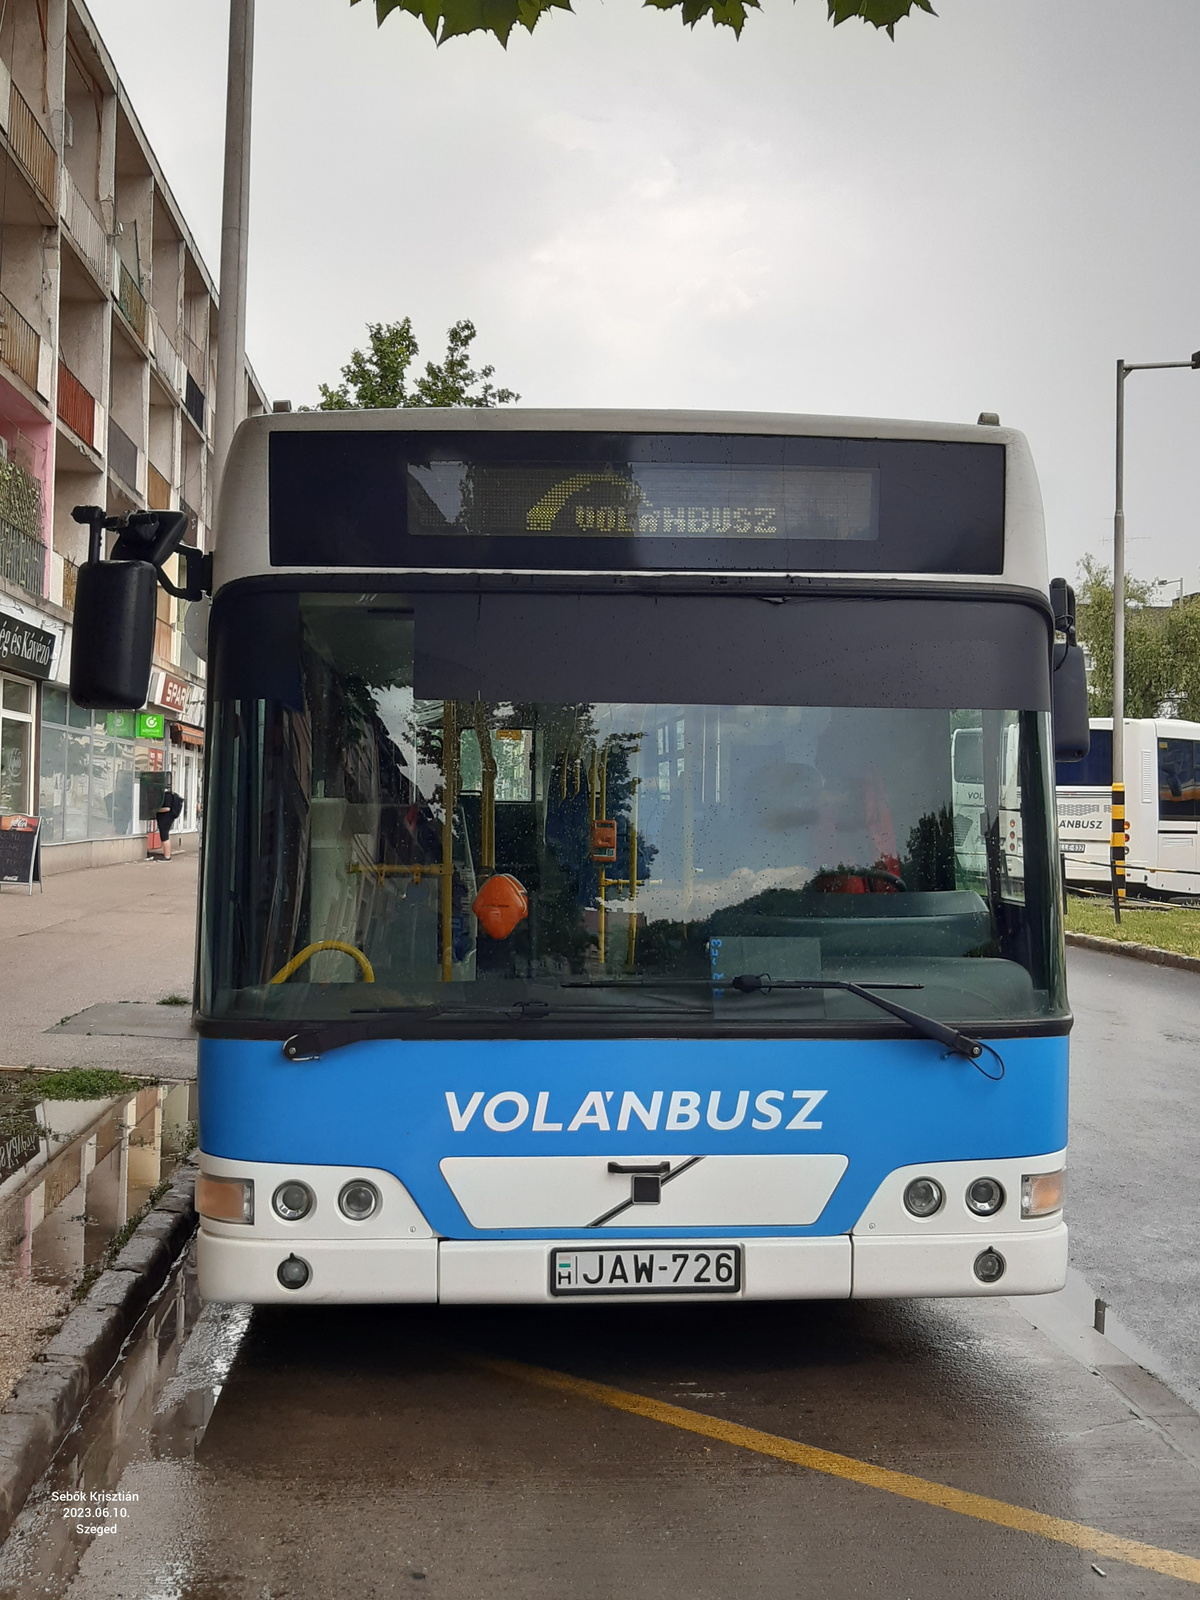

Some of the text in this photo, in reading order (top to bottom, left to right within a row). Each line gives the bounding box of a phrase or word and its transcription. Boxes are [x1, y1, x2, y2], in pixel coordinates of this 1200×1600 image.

[10, 625, 22, 656] és
[20, 630, 51, 666] Kávézó
[165, 681, 188, 707] SPAR
[444, 1089, 829, 1133] VOLÁNBUSZ
[557, 1252, 734, 1285] H JAW-726
